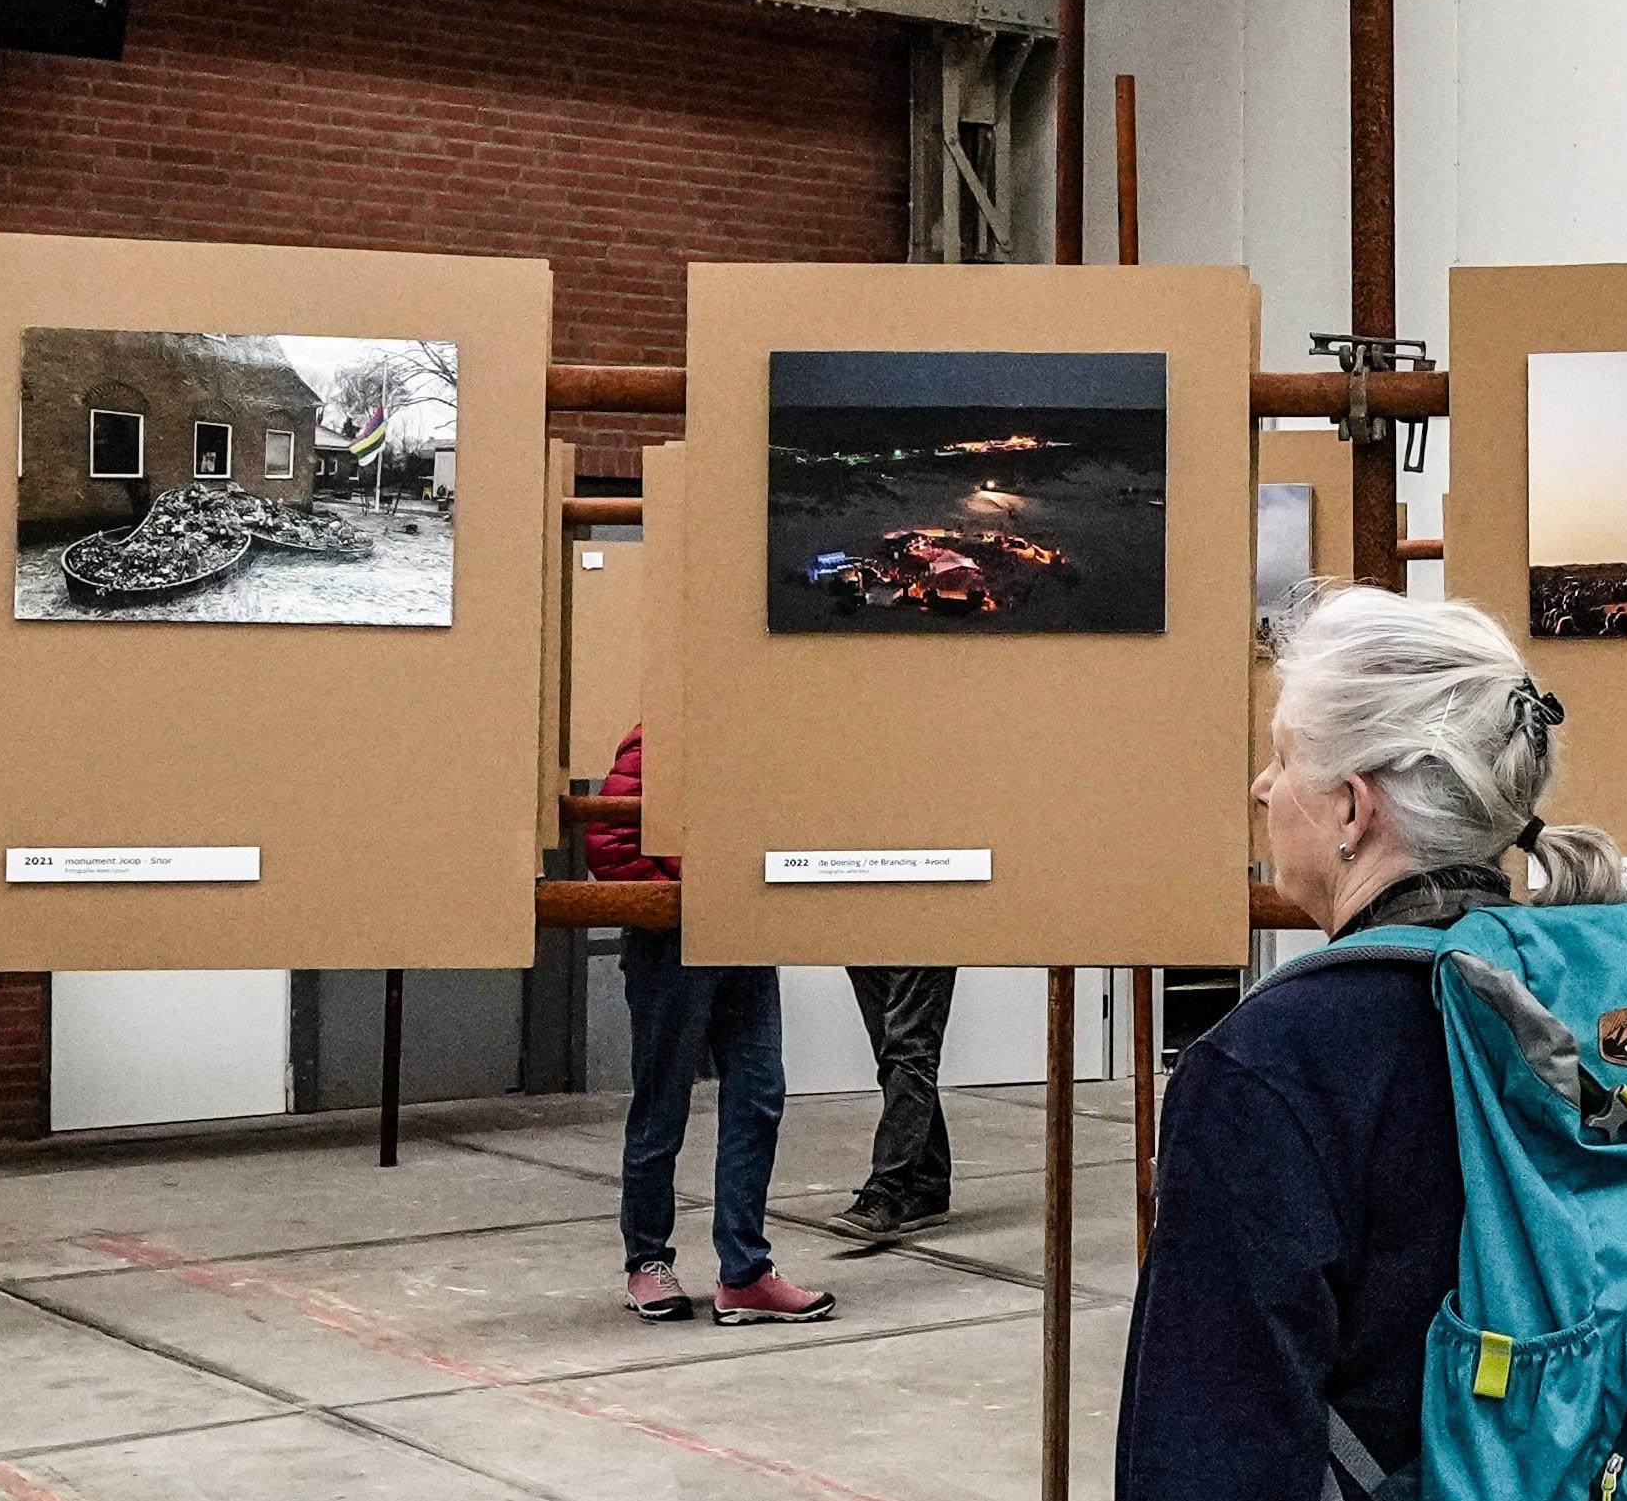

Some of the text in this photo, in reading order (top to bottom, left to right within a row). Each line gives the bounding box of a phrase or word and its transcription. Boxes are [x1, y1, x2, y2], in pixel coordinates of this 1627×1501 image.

[24, 856, 53, 866] 2021
[65, 856, 116, 865] monument
[118, 857, 141, 866] Joop
[150, 856, 172, 865] Snor
[783, 858, 809, 867] 2022
[818, 859, 828, 867] de
[869, 859, 879, 867] de
[881, 858, 916, 868] Branding
[924, 858, 950, 866] Avond
